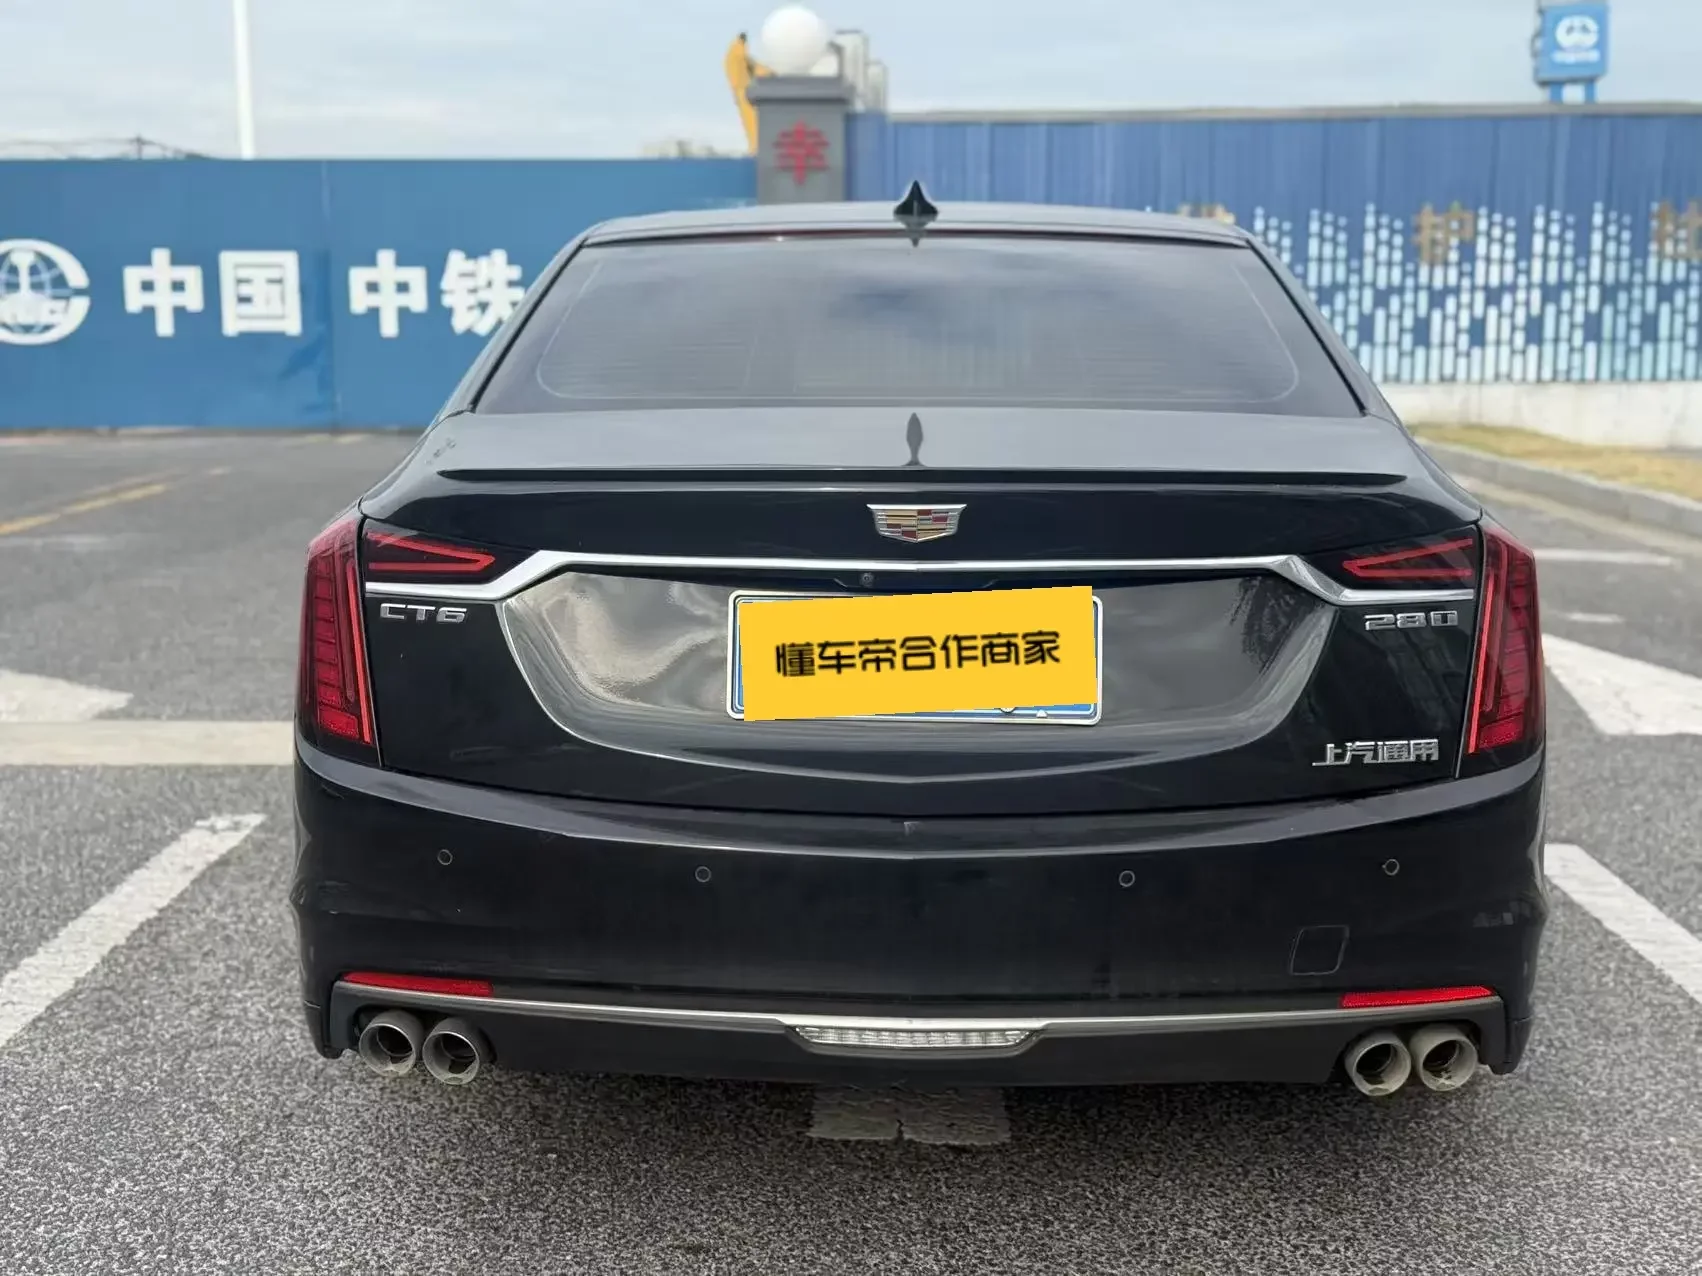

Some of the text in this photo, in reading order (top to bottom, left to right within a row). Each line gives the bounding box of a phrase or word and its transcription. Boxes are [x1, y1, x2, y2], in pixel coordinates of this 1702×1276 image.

[123, 247, 526, 338] 中国 中铁
[380, 603, 468, 622] CT6
[1312, 738, 1438, 766] 上汽通用
